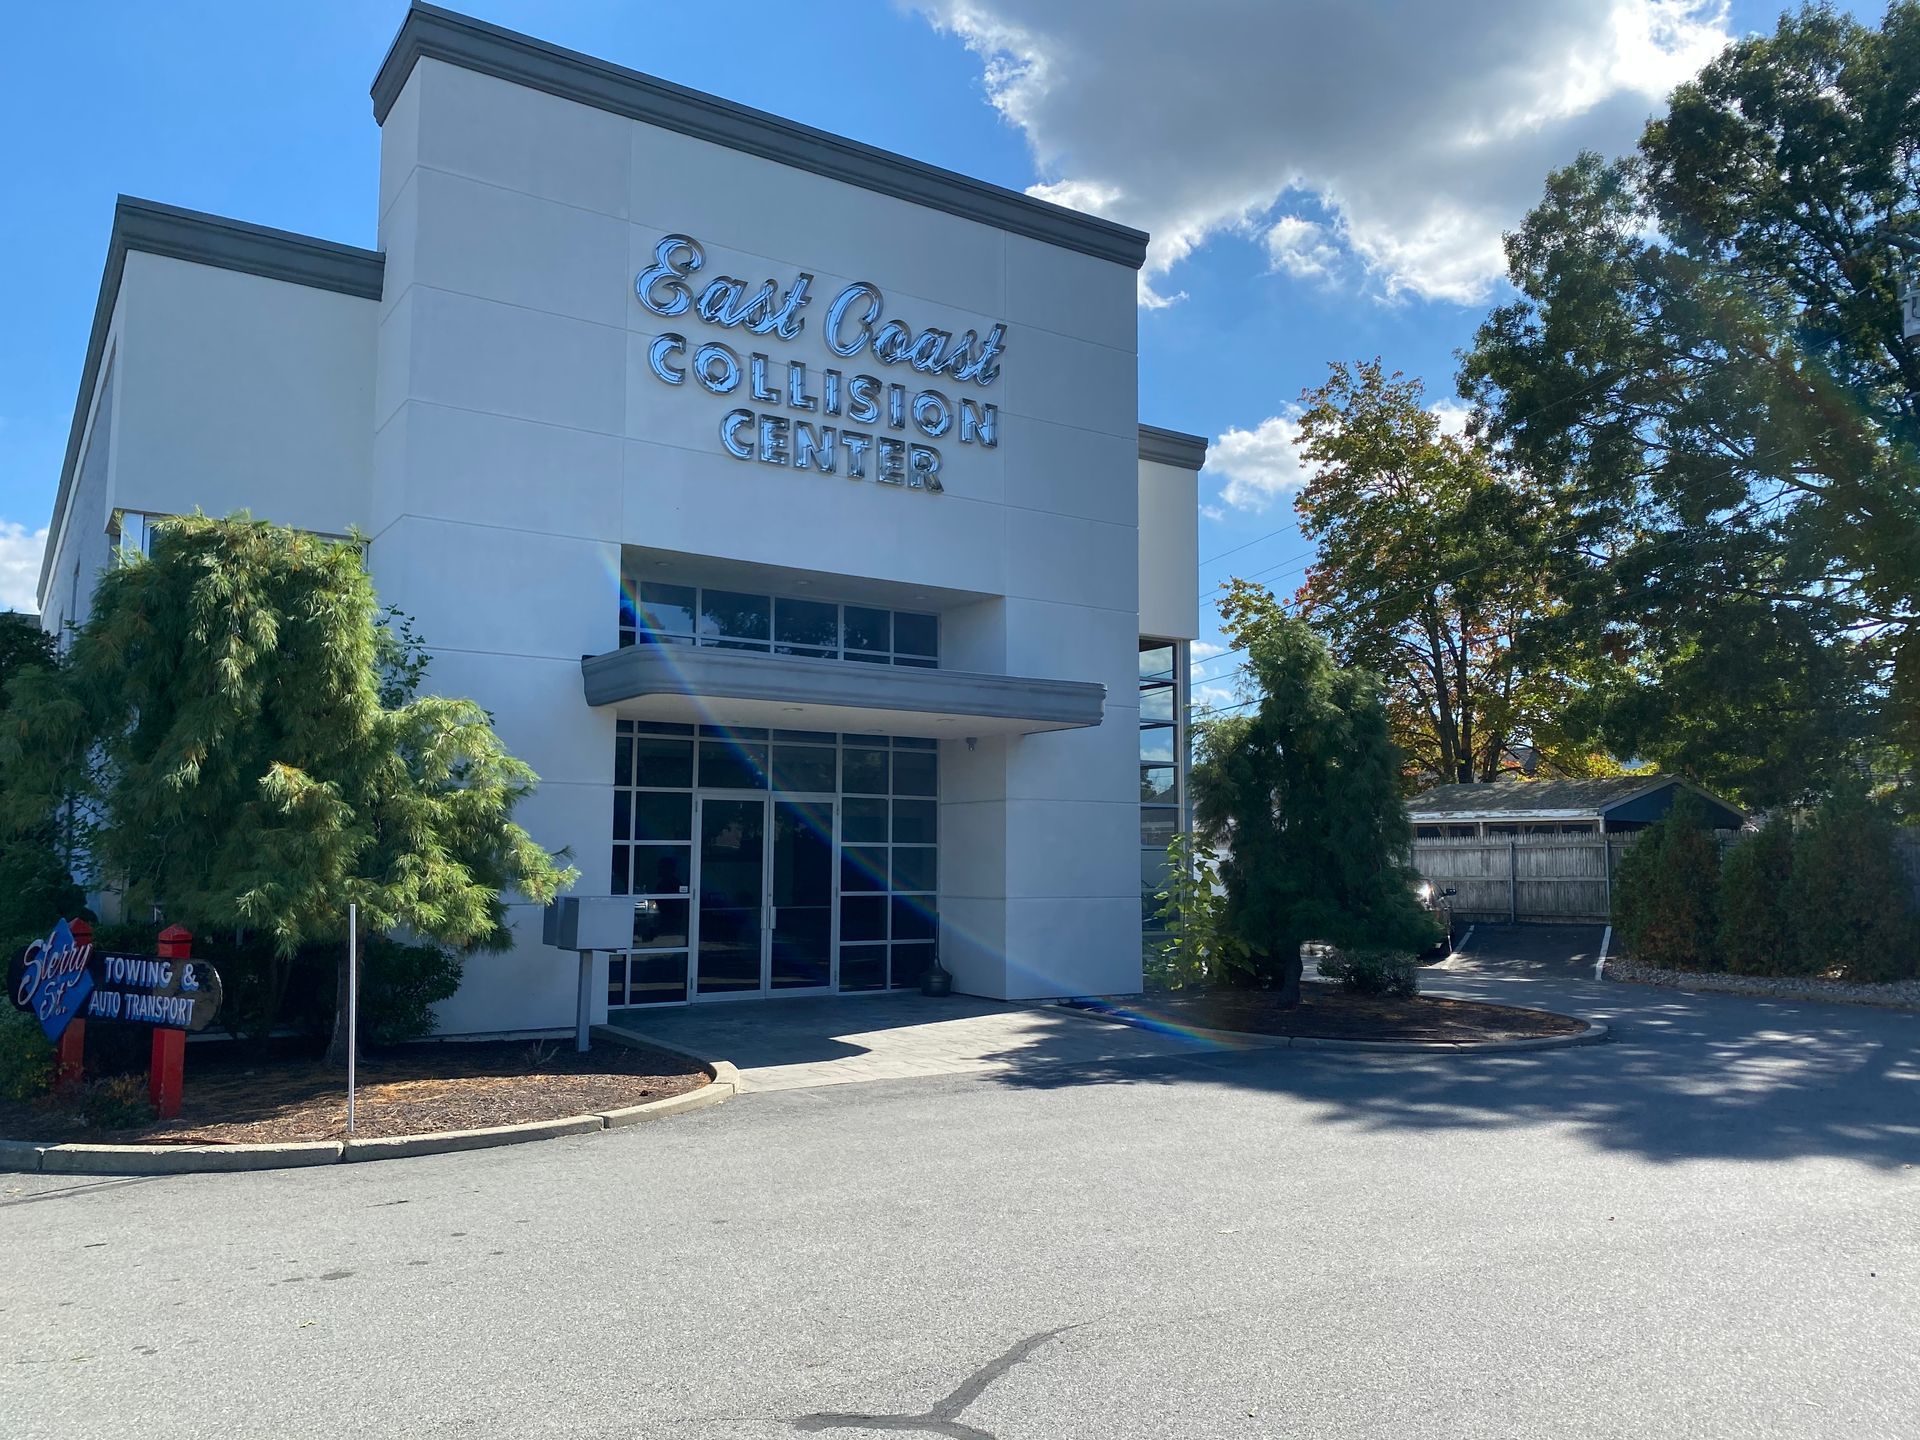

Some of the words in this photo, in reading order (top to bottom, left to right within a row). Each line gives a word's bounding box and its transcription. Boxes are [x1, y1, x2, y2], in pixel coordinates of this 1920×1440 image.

[634, 233, 814, 341] East
[823, 281, 1008, 387] Coast
[647, 333, 999, 448] COLLISION
[719, 408, 944, 493] CENTER
[89, 990, 121, 1018] AUTO
[124, 993, 195, 1025] TRANSPORT
[104, 957, 173, 988] TOWING
[181, 963, 199, 991] &
